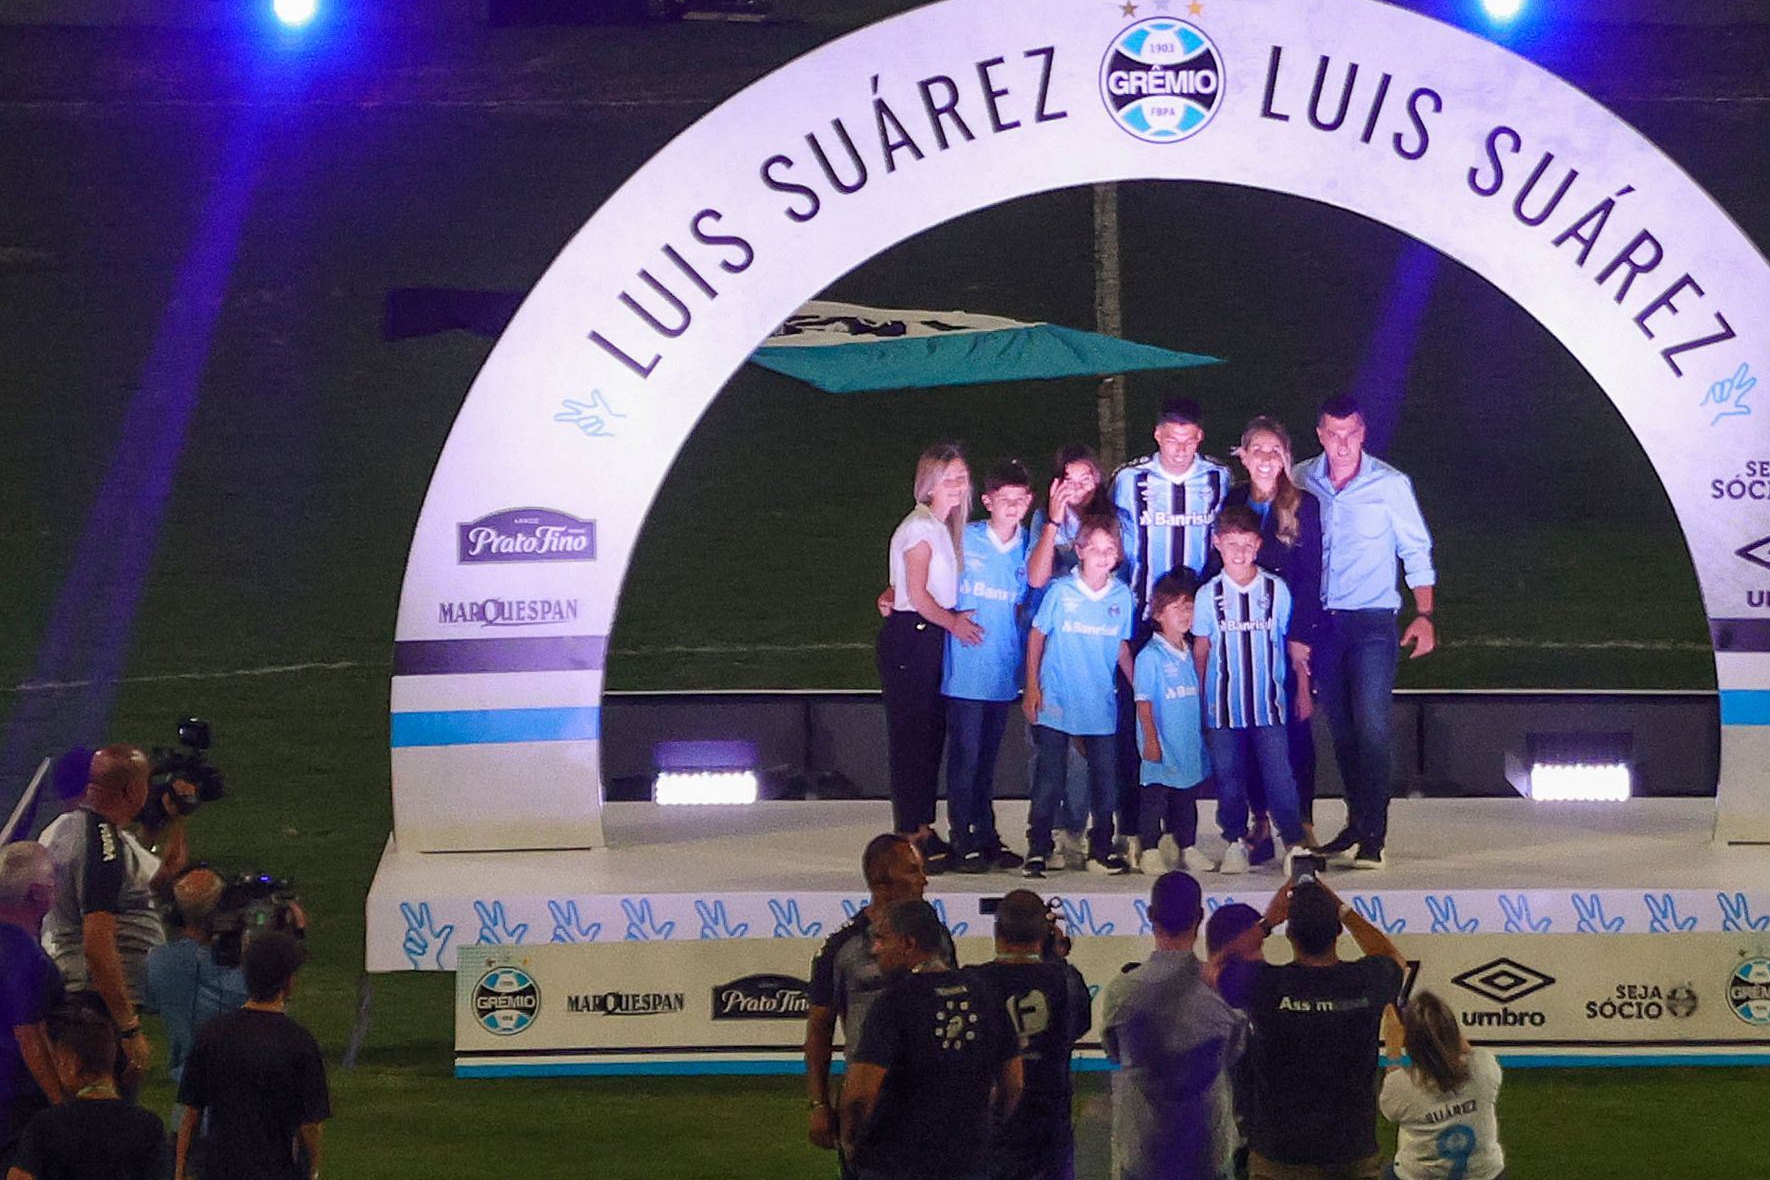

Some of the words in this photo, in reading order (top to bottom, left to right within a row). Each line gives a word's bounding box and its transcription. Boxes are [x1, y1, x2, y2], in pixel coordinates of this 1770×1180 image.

[1108, 65, 1217, 95] GRÊMIO
[588, 208, 754, 379] LUIS
[760, 46, 1068, 222] SUÁREZ
[1260, 45, 1443, 161] LUIS
[1468, 126, 1737, 378] SUÁREZ
[438, 599, 578, 625] MARQUESPAN
[568, 991, 685, 1016] MARQUESPAN
[1616, 984, 1662, 1000] SEJA
[1462, 1009, 1545, 1027] umbro
[1585, 997, 1662, 1020] SÓCIO
